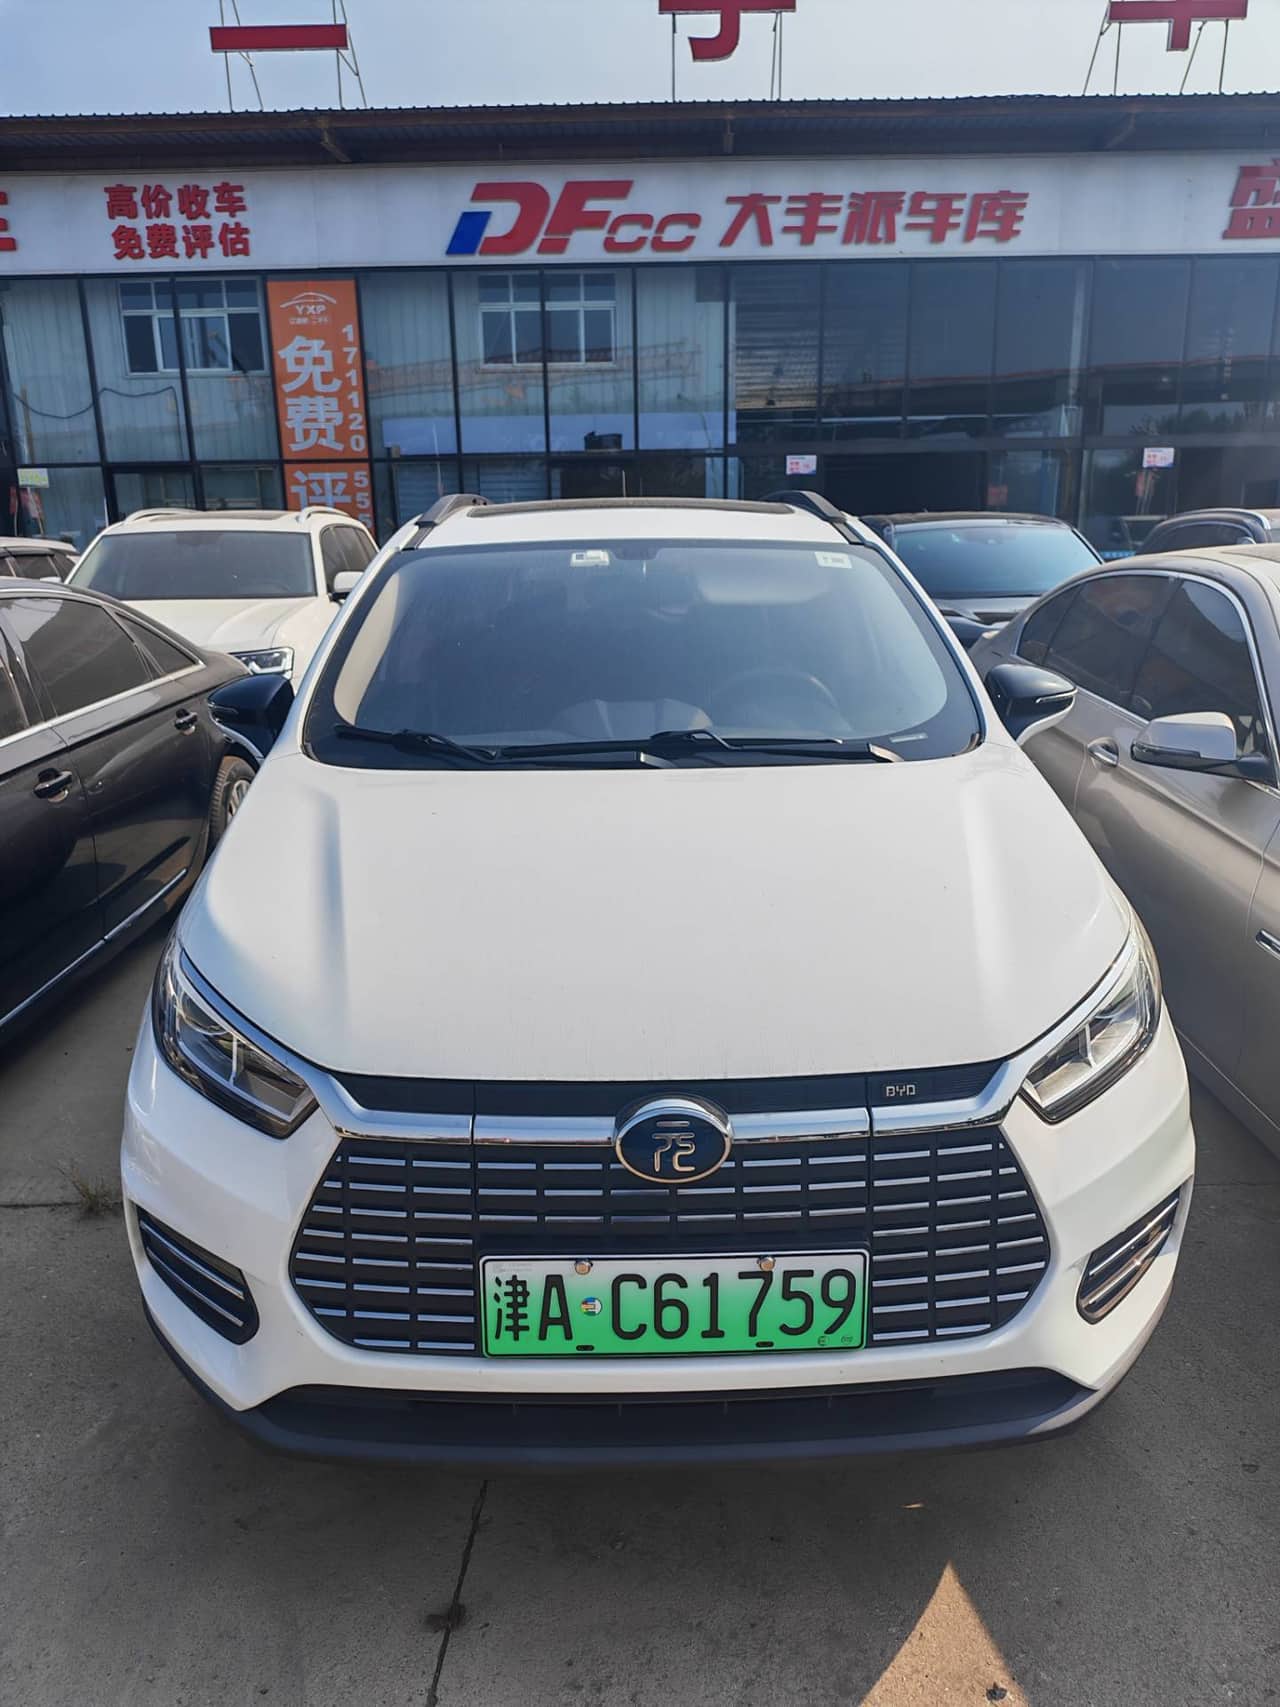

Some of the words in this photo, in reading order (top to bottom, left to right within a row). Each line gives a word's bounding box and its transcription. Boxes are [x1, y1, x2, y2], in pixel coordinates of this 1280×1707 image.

[104, 182, 247, 220] 高价收车
[719, 190, 1029, 246] 大丰派车库
[111, 222, 250, 259] 免费评估
[886, 1084, 916, 1097] BYD
[651, 1119, 697, 1173] 元
